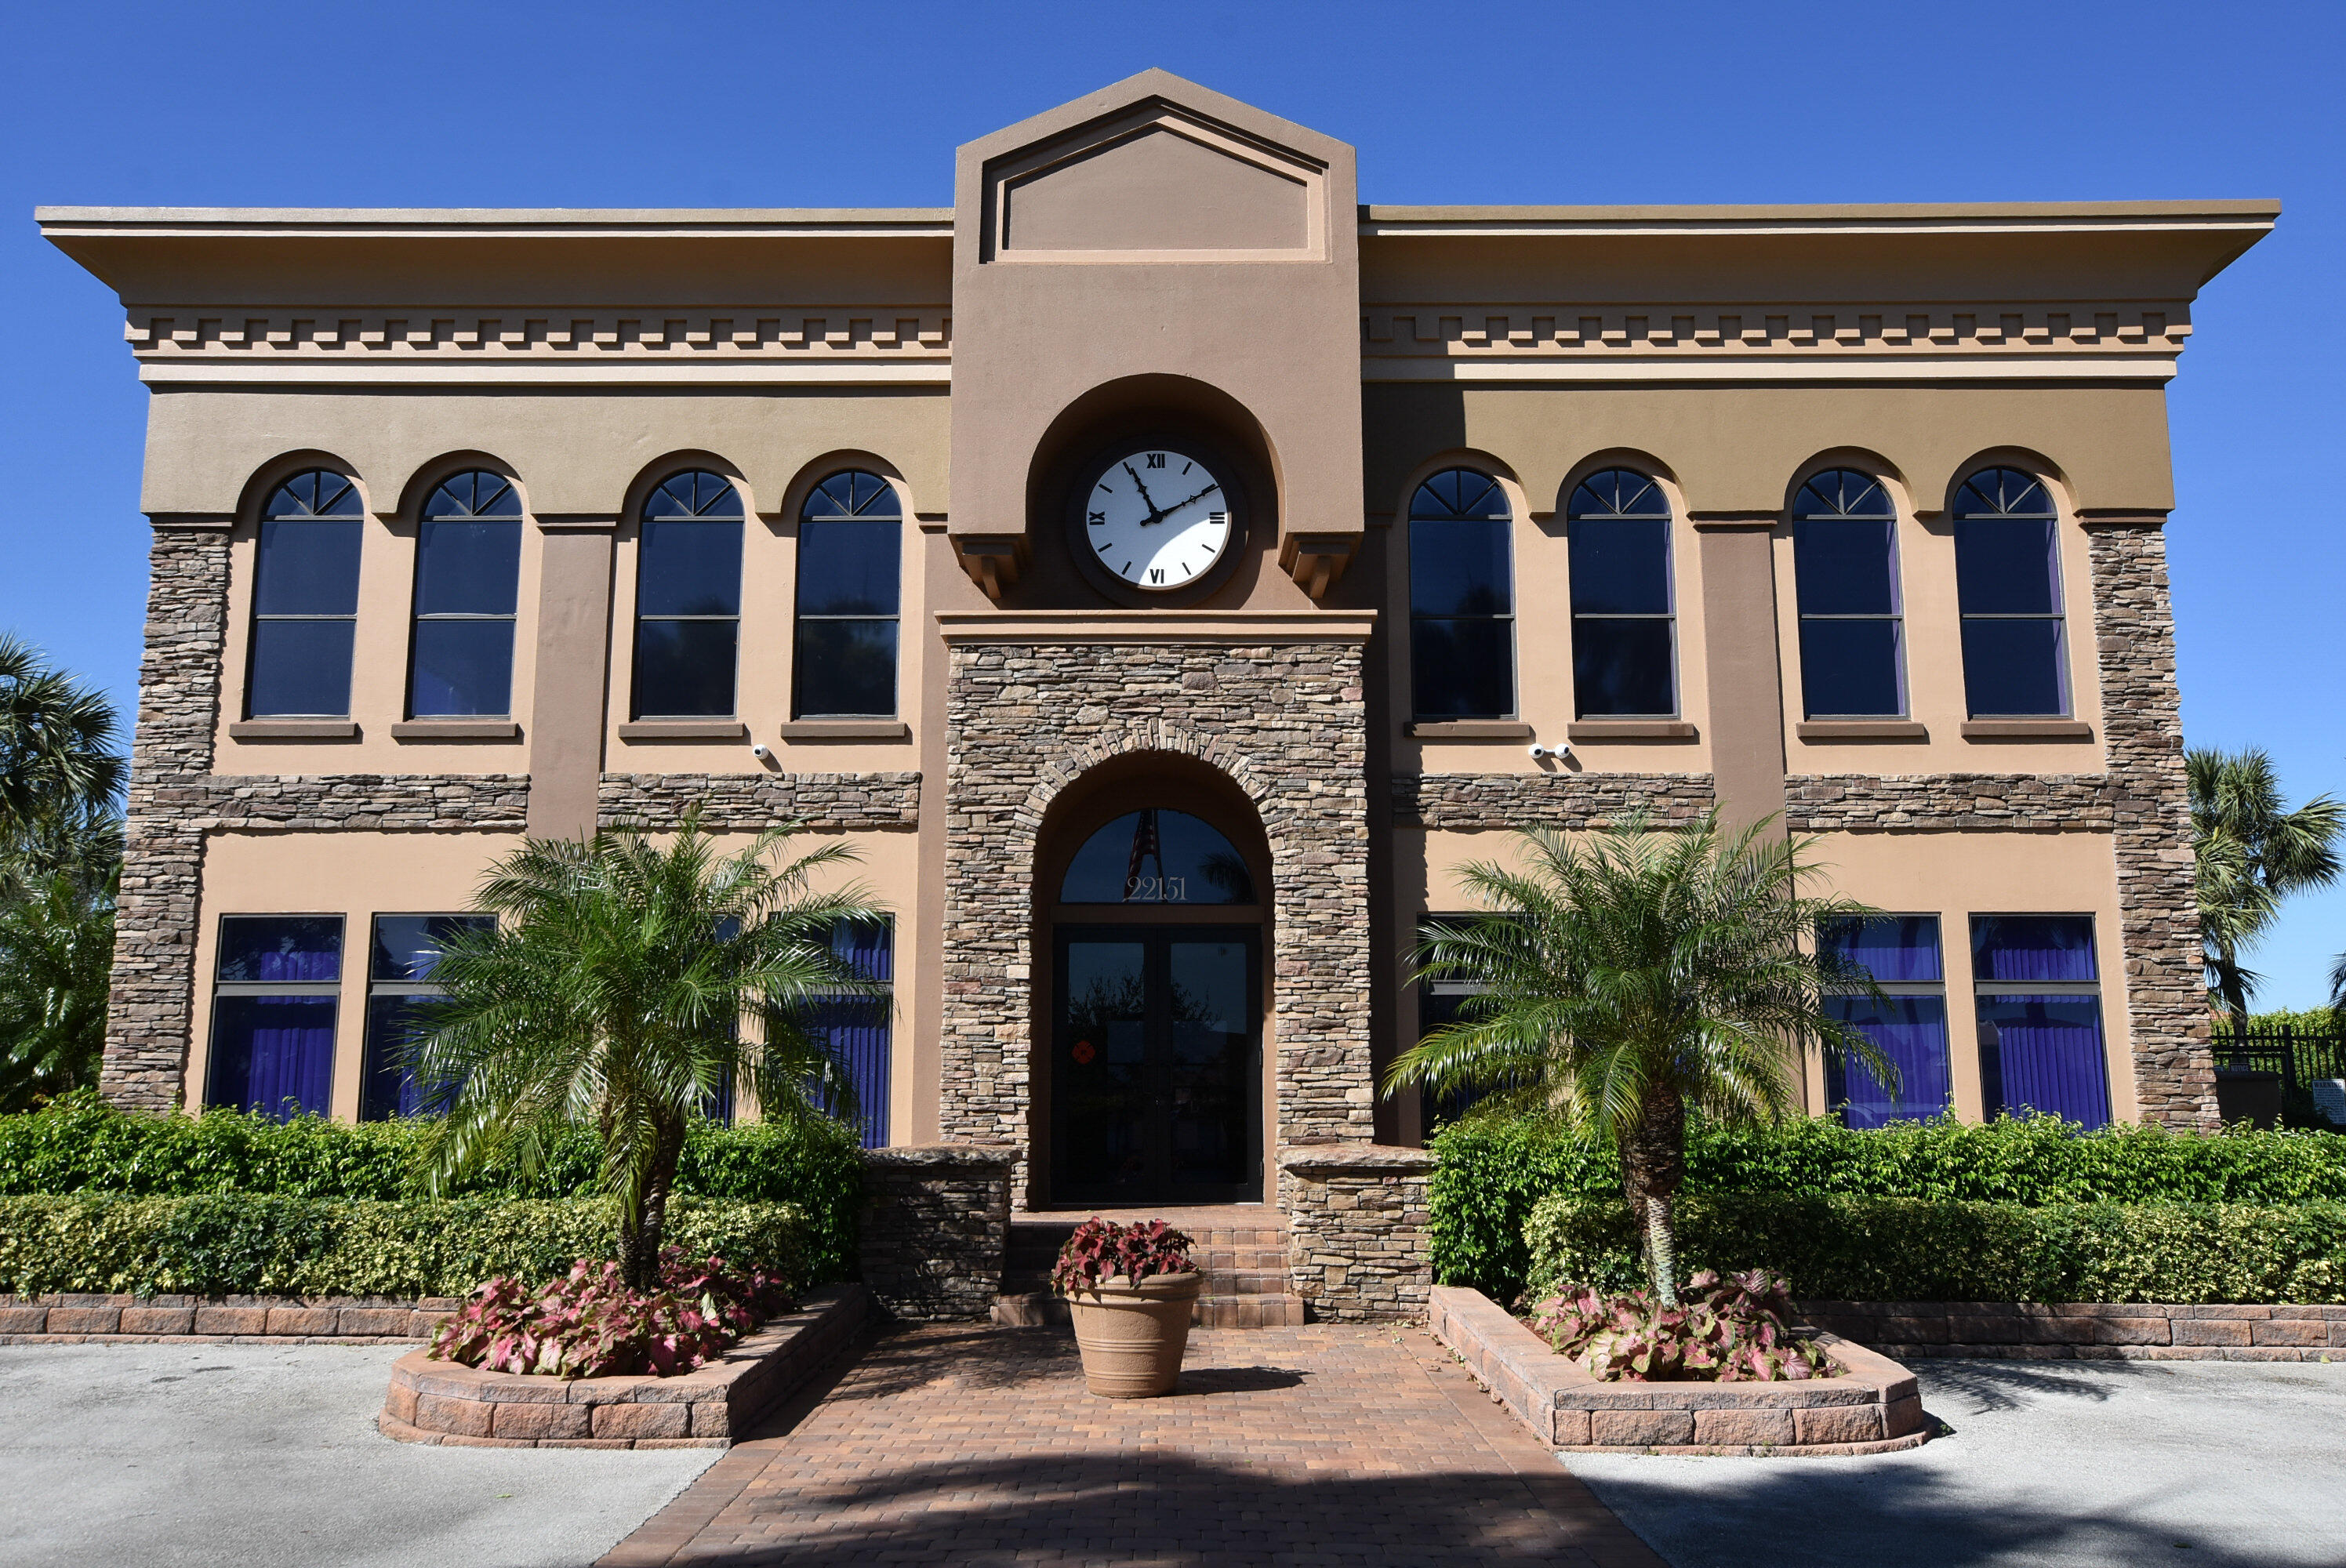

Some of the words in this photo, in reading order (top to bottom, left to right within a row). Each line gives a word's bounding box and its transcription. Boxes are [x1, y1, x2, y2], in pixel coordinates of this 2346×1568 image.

[1146, 453, 1165, 469] XII
[1089, 511, 1105, 525] IX
[1209, 512, 1225, 524] III
[1149, 568, 1164, 583] VI
[1127, 876, 1187, 900] 22151
